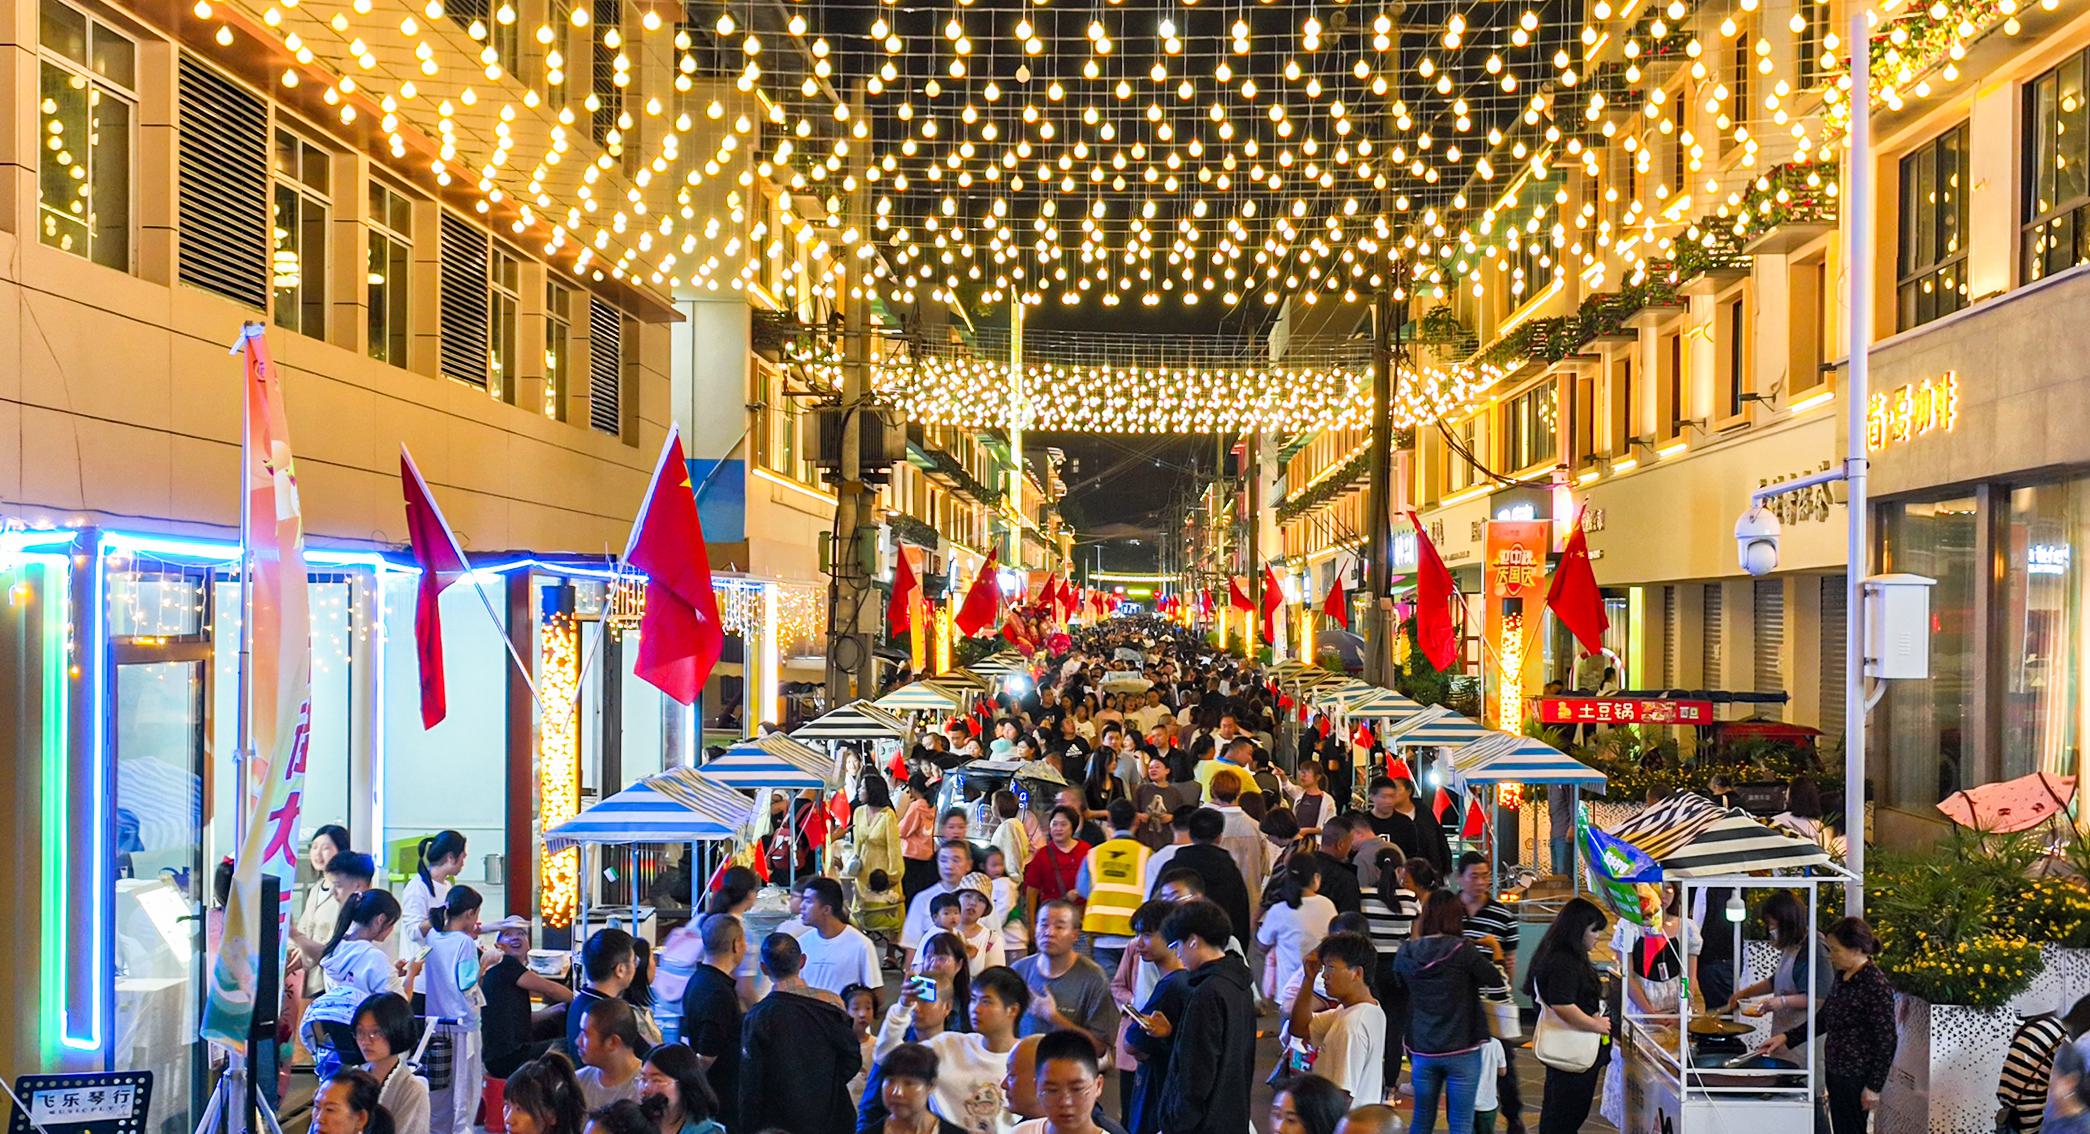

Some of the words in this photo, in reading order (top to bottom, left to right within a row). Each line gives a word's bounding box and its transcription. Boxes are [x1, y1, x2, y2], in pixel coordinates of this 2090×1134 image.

[1495, 566, 1536, 587] 庆国庆
[1578, 702, 1634, 721] 土豆锅
[37, 1089, 131, 1108] 飞乐琴行
